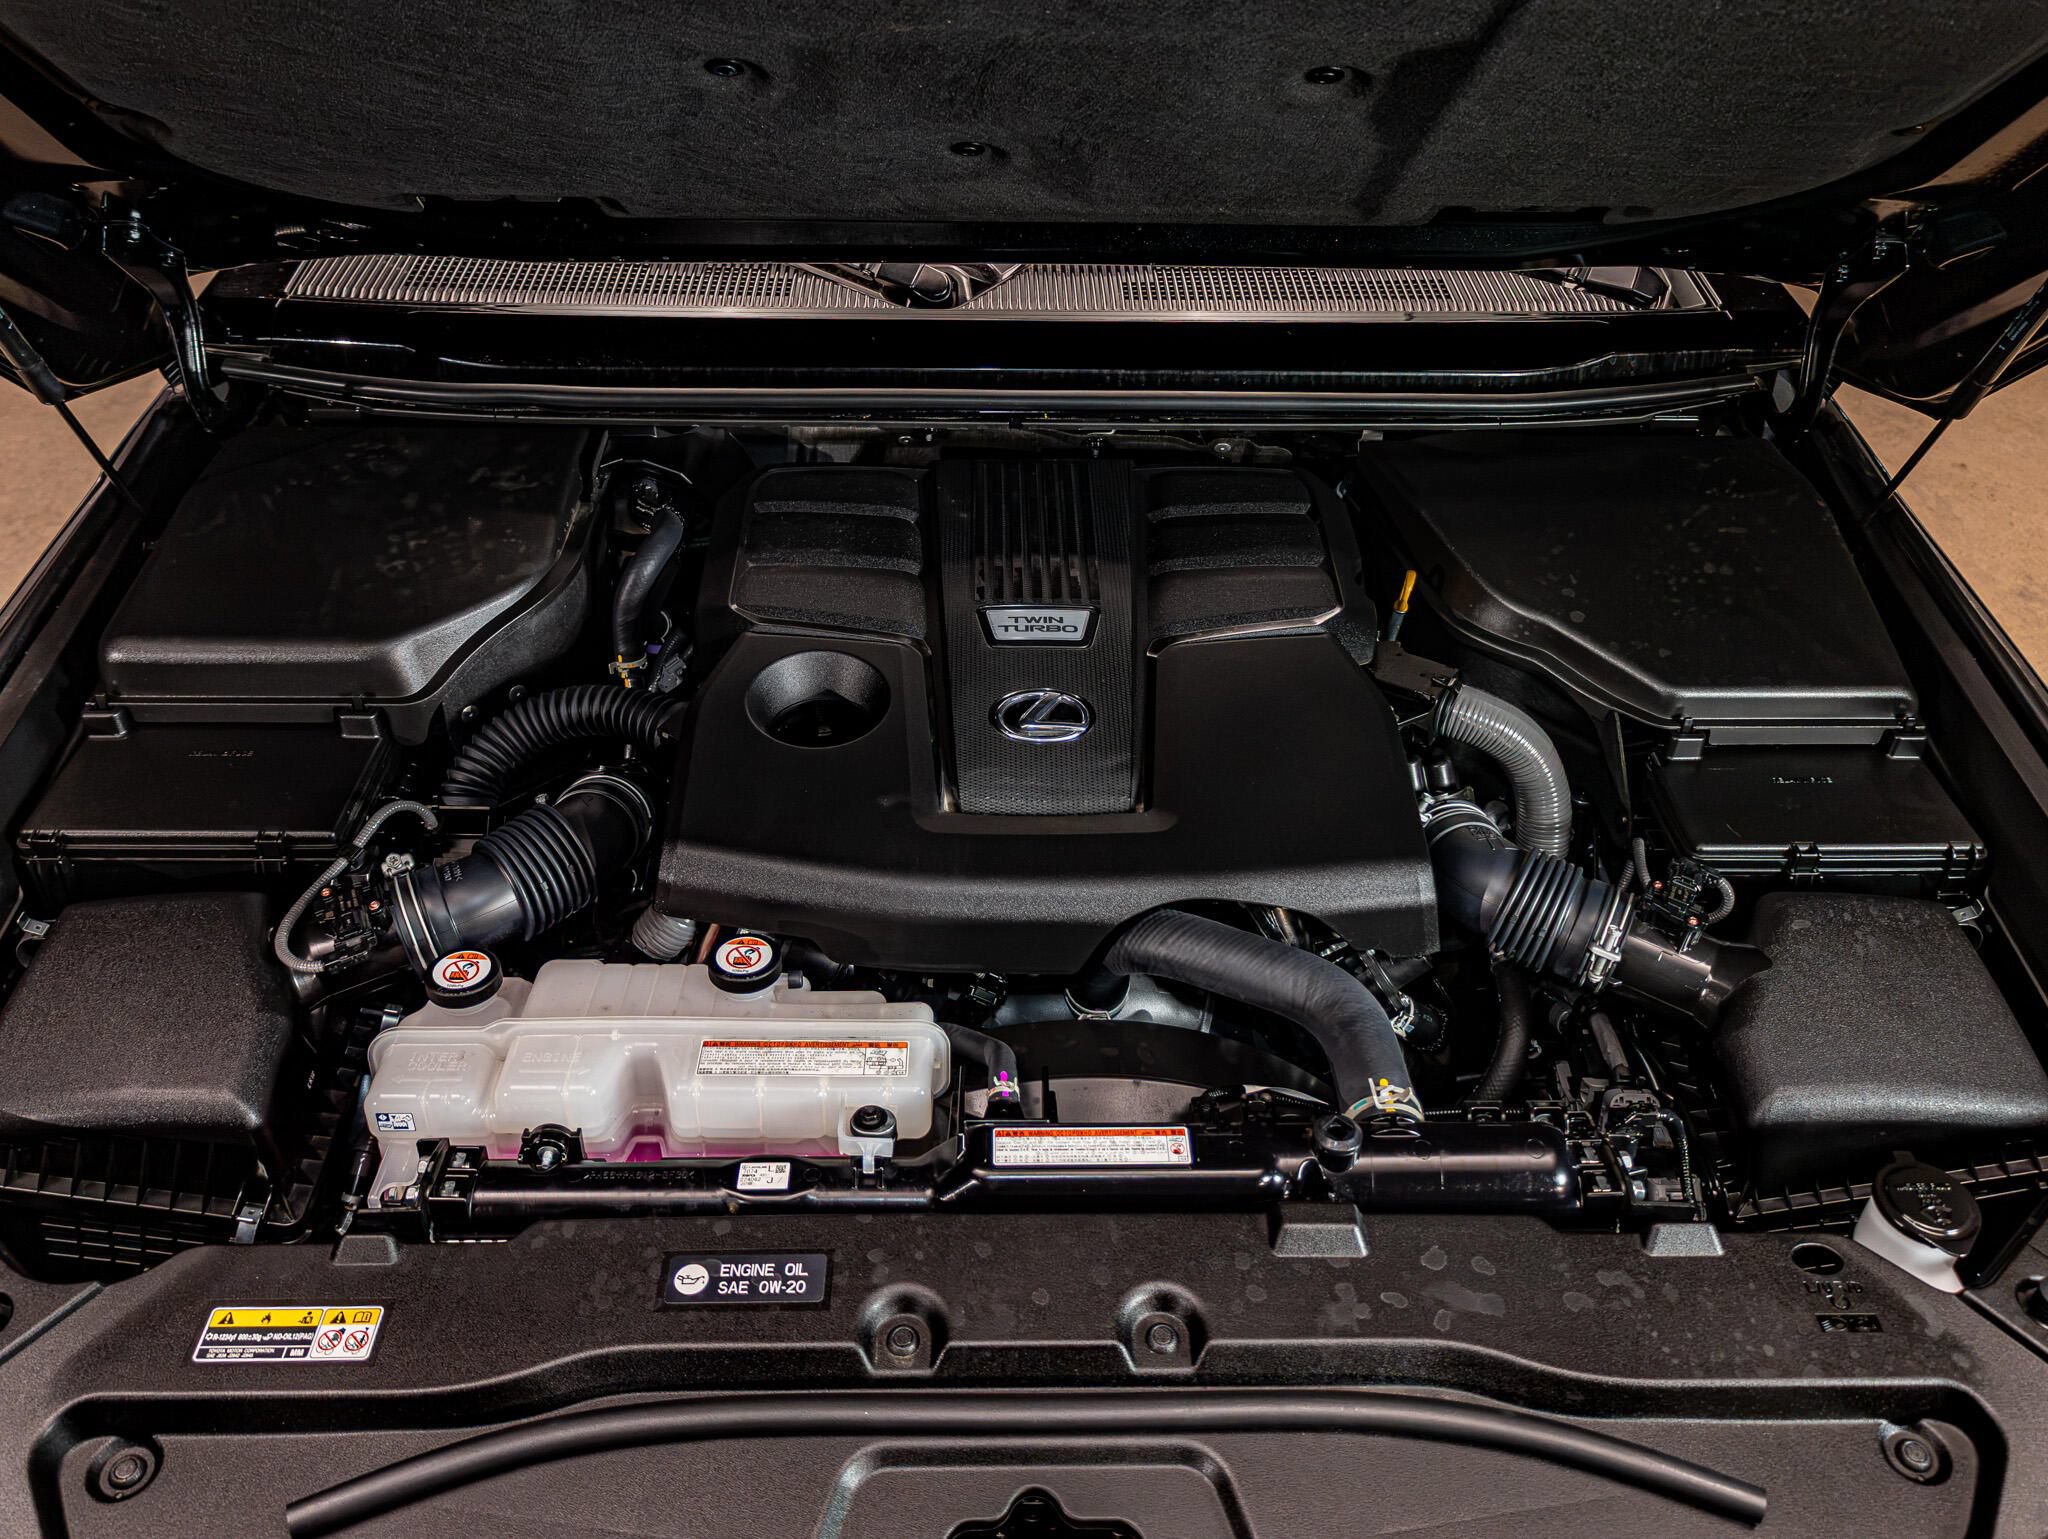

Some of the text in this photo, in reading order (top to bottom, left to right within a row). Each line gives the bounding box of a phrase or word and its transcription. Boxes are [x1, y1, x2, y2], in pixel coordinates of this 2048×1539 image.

[1007, 616, 1064, 624] TWIN
[997, 624, 1079, 633] TURBO
[521, 1051, 582, 1064] ENGINE
[719, 1262, 809, 1277] ENGINE OIL
[717, 1280, 807, 1295] SAE 0W-20
